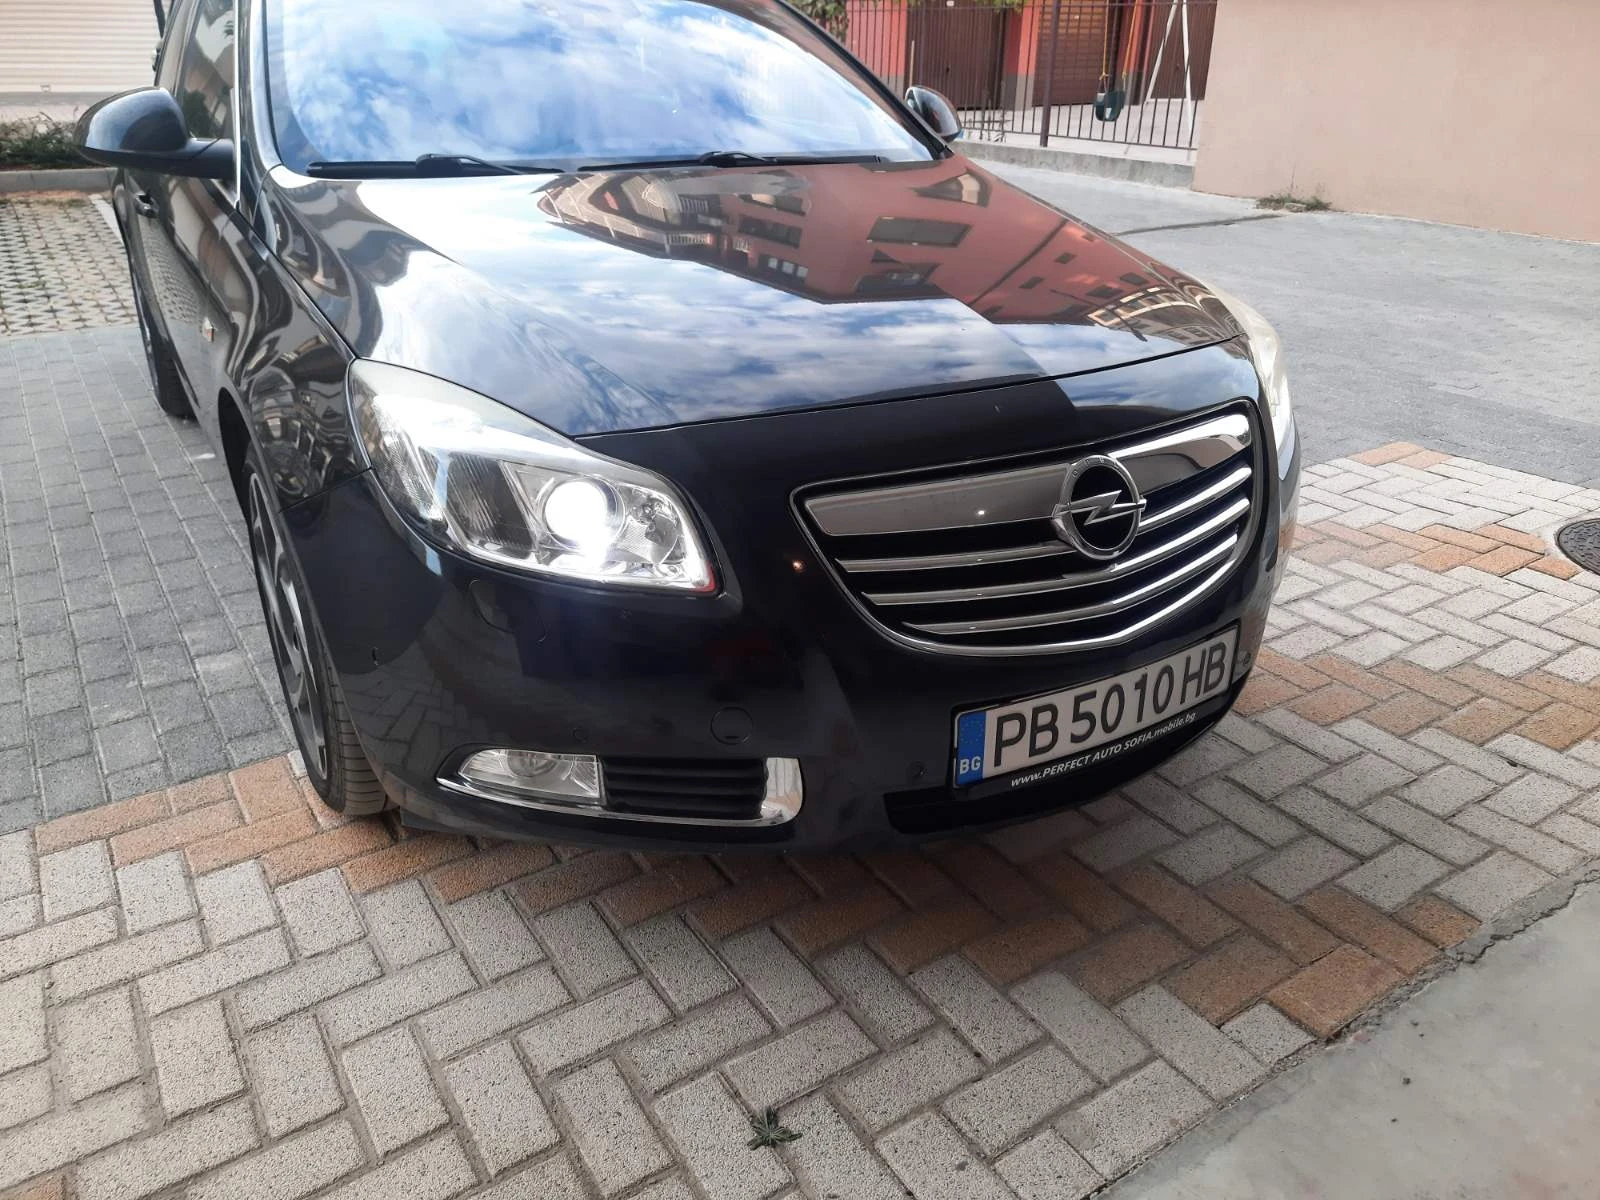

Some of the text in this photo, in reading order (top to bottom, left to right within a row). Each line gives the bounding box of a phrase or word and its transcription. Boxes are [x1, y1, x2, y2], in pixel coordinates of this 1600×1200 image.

[994, 703, 1059, 767] PB
[1092, 744, 1121, 762] AUTO
[959, 756, 981, 774] BG
